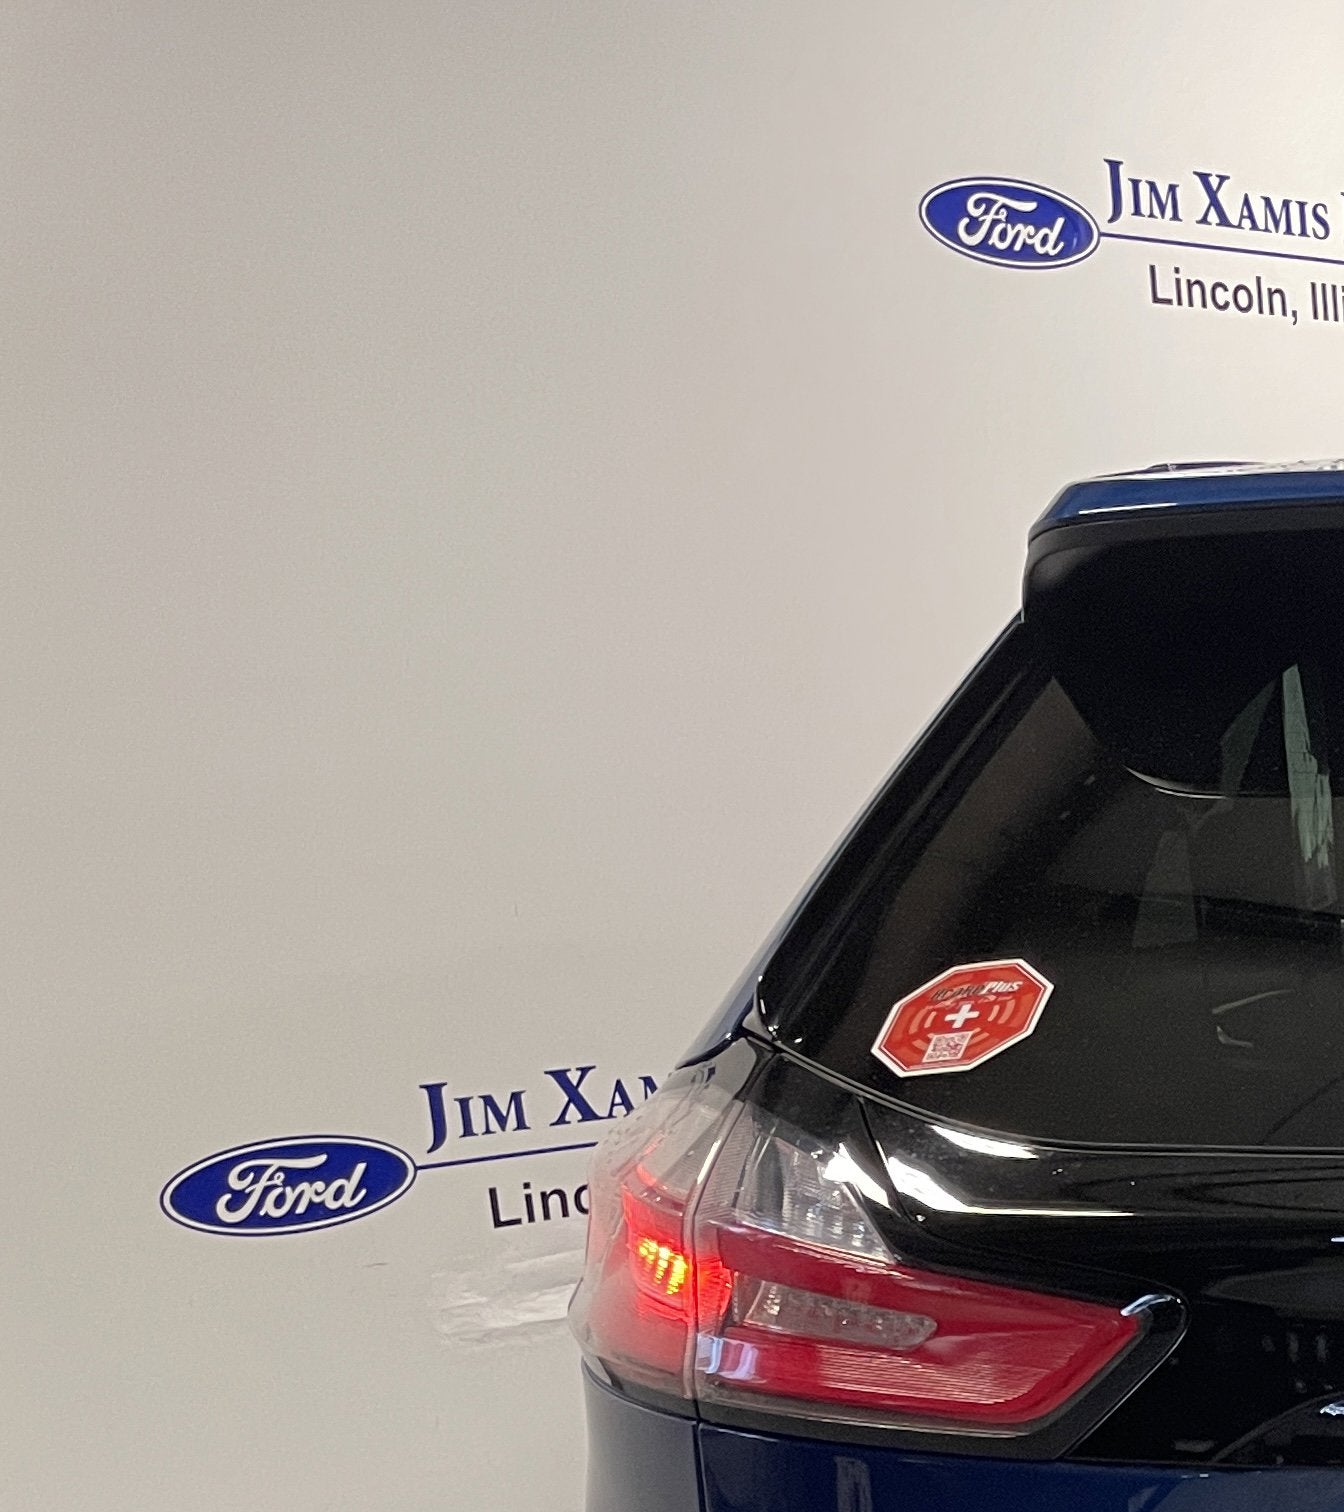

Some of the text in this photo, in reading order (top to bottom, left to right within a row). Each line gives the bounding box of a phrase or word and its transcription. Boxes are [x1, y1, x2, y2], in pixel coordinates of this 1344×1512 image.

[957, 192, 1066, 257] Ford
[1103, 159, 1182, 224] JIM
[1193, 171, 1330, 241] XAMIS
[1149, 264, 1298, 326] Lincoln,
[418, 1081, 532, 1154] JIM
[216, 1153, 368, 1224] Ford
